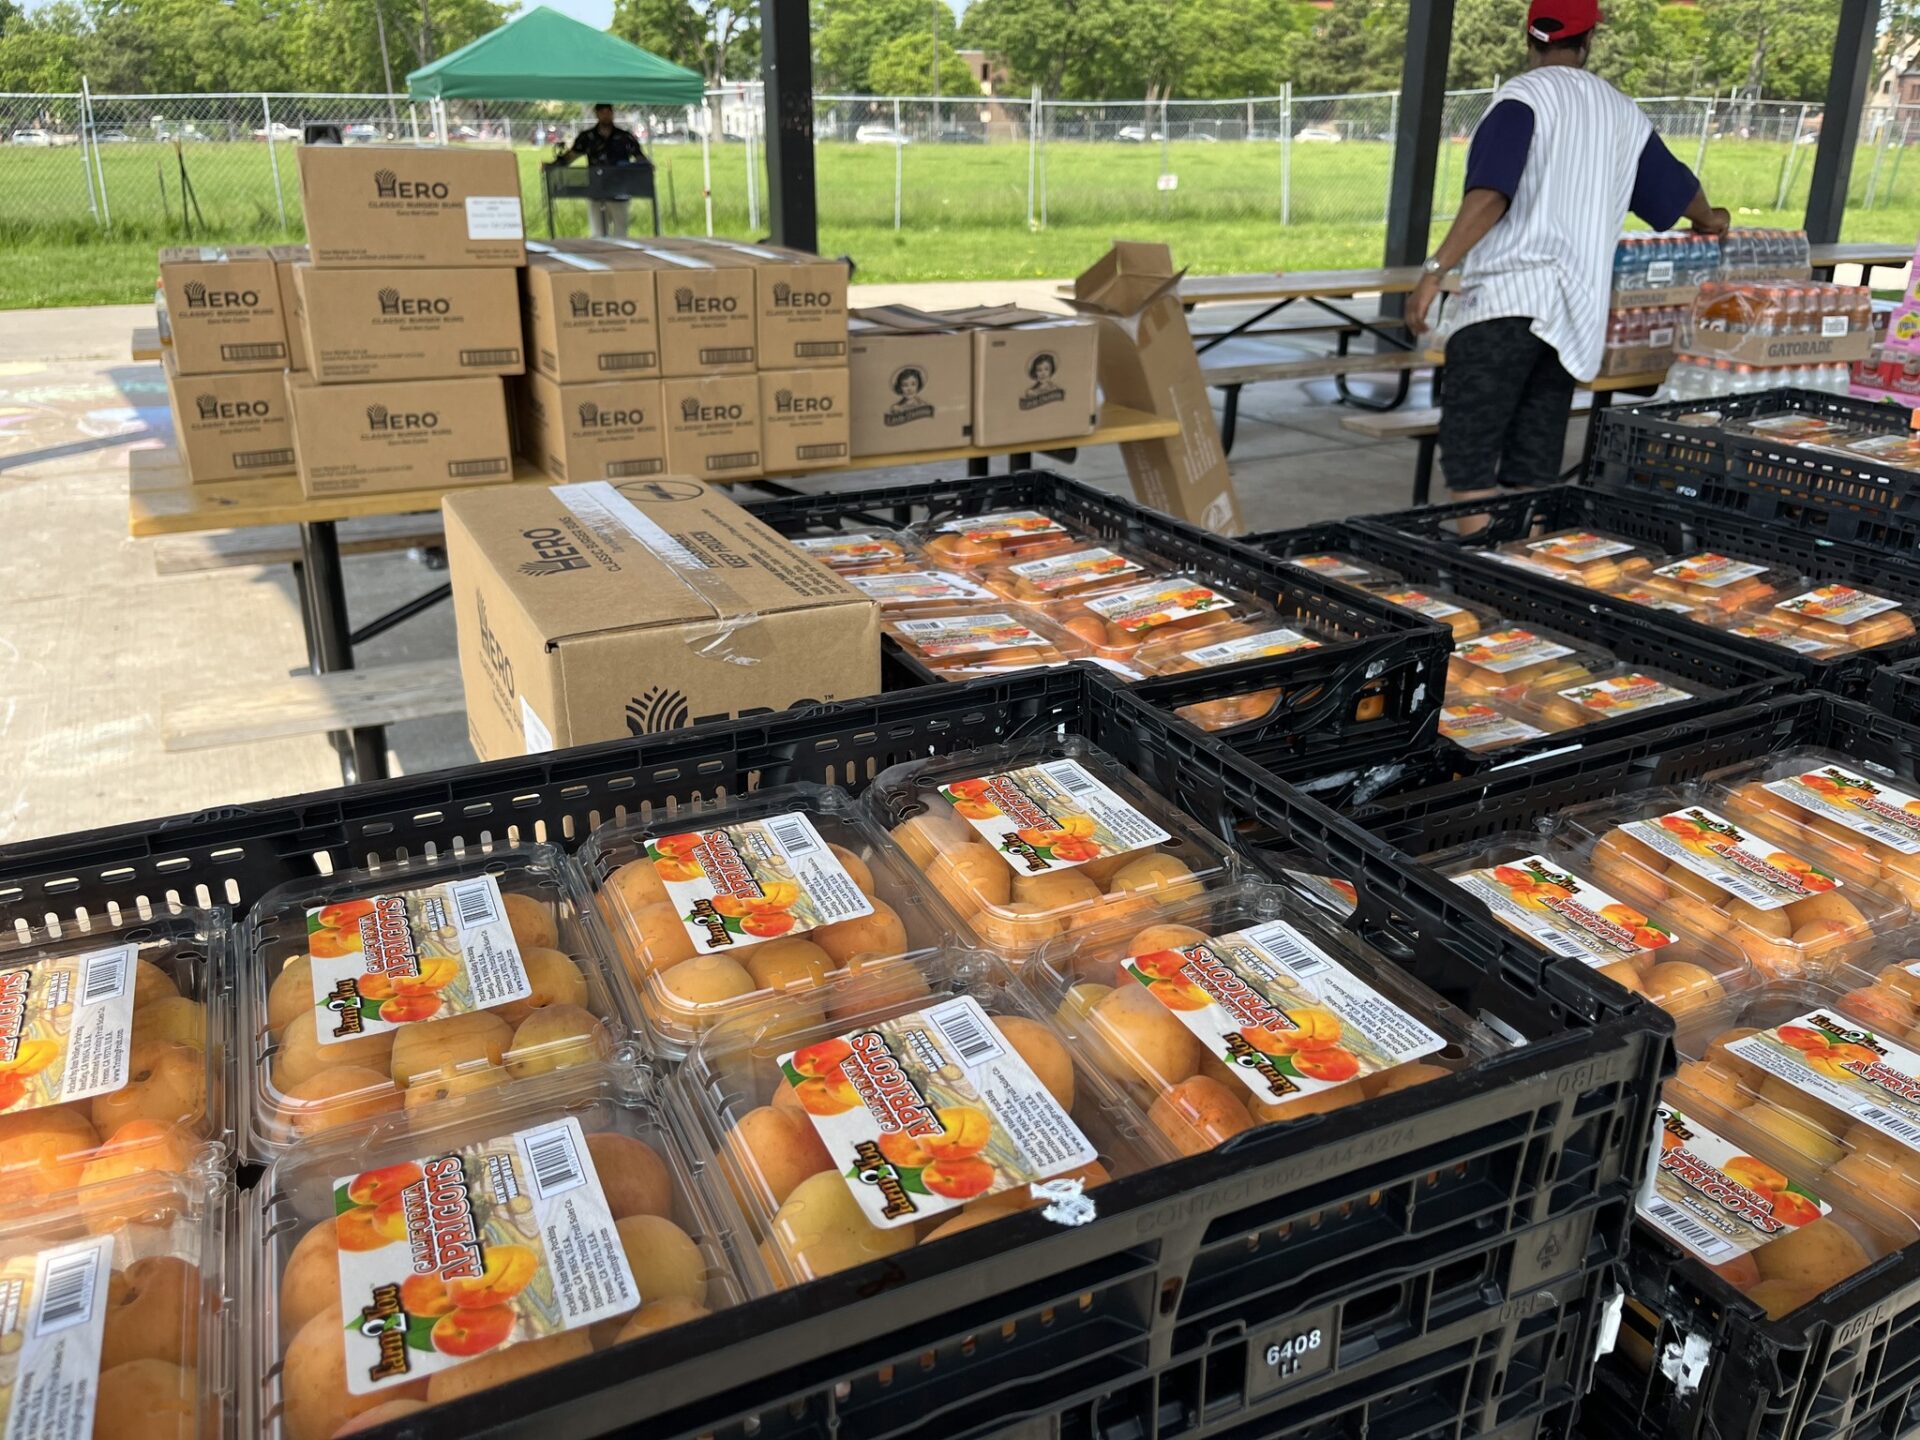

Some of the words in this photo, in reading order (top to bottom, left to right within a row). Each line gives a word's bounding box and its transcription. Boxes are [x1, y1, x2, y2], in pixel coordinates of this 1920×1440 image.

[374, 173, 449, 199] HERO
[183, 283, 259, 308] HERO
[377, 289, 451, 315] HERO
[569, 293, 636, 318] HERO
[674, 289, 737, 314] HERO
[773, 283, 831, 308] HERO
[1768, 340, 1832, 359] GATORADE
[196, 394, 270, 420] HERO
[680, 400, 742, 423] HERO
[775, 392, 832, 413] HERO
[367, 405, 438, 430] HERO
[579, 403, 644, 428] HERO
[556, 516, 580, 529] BUNS
[569, 529, 600, 548] BURGER
[519, 527, 591, 577] HERO
[588, 549, 623, 571] CLASSIC
[715, 552, 753, 568] KEEP
[477, 600, 515, 698] HERO
[988, 778, 1063, 831] APRICOTS
[692, 844, 732, 895] CALIFORNIA
[702, 831, 763, 899] APRICOTS
[1537, 895, 1640, 953] APRICOTS
[359, 912, 385, 974] CALIFORNIA
[375, 897, 417, 978] APRICOTS
[1176, 964, 1259, 1028] CALIFORNIA
[1178, 947, 1300, 1031] APRICOTS
[989, 1066, 1001, 1075] Co.
[995, 1074, 1011, 1088] Sales
[840, 1054, 902, 1133] CALIFORNIA
[849, 1032, 944, 1138] APRICOTS
[1005, 1087, 1022, 1102] Fruit
[983, 1089, 1006, 1112] Packing
[1002, 1098, 1019, 1114] U.S.A.
[1015, 1100, 1038, 1121] Trinity
[1022, 1093, 1040, 1110] U.S.A.
[1012, 1128, 1025, 1139] Sun
[1030, 1119, 1043, 1128] by
[1048, 1126, 1060, 1135] CA
[1020, 1138, 1032, 1146] by
[1027, 1131, 1038, 1140] CA
[1672, 1146, 1774, 1214] CALIFORNIA
[563, 1198, 573, 1208] Co.
[1135, 1180, 1249, 1234] CONTACT
[424, 1156, 482, 1280] APRICOTS
[565, 1207, 578, 1223] Sales
[402, 1180, 438, 1275] CALIFORNIA
[545, 1224, 561, 1251] Packing
[570, 1222, 583, 1240] Fruit
[561, 1235, 574, 1254] U.S.A.
[575, 1238, 591, 1263] Trinity
[586, 1230, 599, 1249] U.S.A.
[558, 1270, 569, 1284] Sun
[582, 1260, 594, 1271] by
[598, 1268, 608, 1279] CA
[561, 1282, 573, 1292] by
[572, 1274, 583, 1284] CA
[1266, 1329, 1322, 1366] 6408
